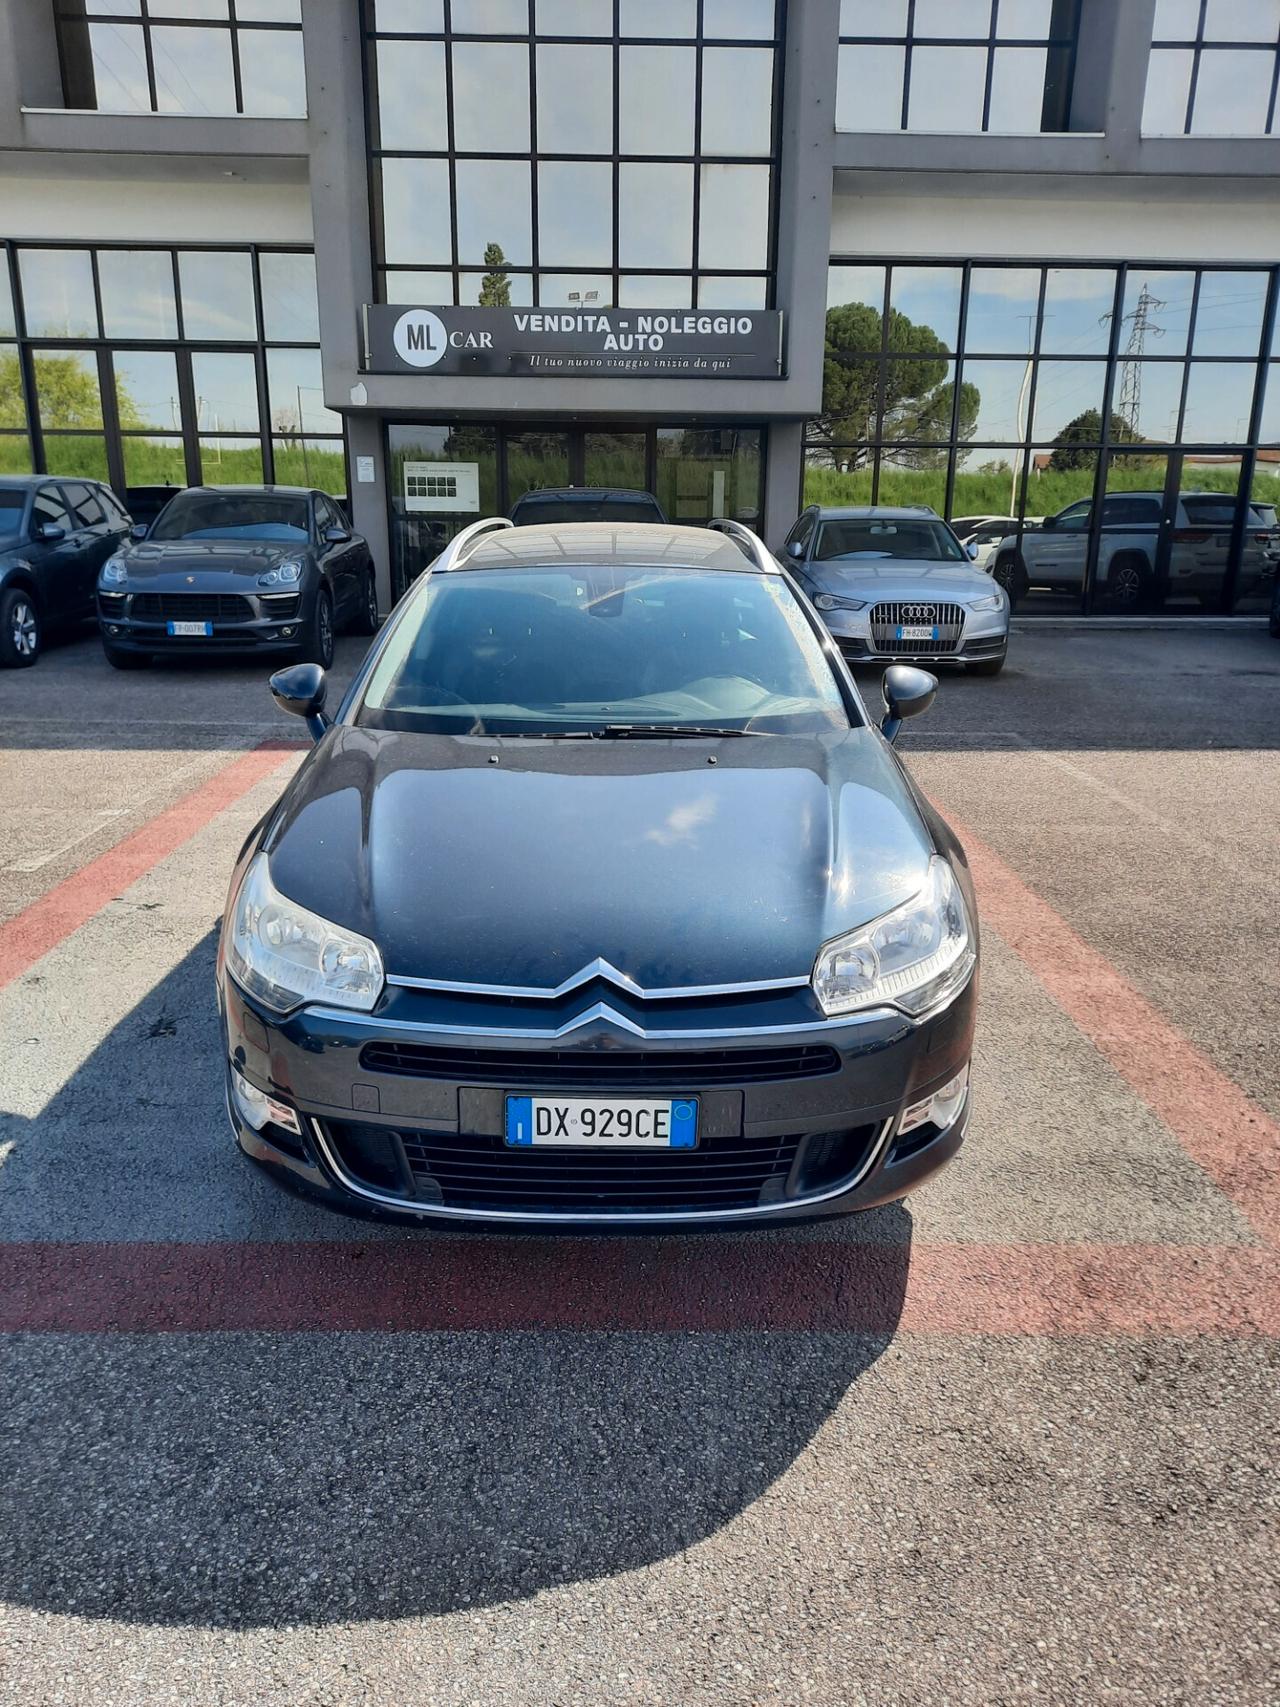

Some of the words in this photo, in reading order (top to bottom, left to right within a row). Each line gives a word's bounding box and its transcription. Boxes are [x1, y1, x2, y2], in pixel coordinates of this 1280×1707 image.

[513, 314, 611, 333] VENDITA
[637, 316, 753, 335] NOLEGGIO
[407, 324, 437, 350] ML
[449, 331, 493, 348] CAR
[603, 334, 664, 351] AUTO
[529, 355, 541, 366] Il
[544, 357, 563, 367] tuo
[567, 358, 603, 367] nuovo
[606, 357, 650, 369] viaggio
[654, 357, 689, 368] inizia
[693, 357, 708, 368] da
[712, 358, 731, 369] qui
[536, 1106, 569, 1137] DX
[580, 1108, 670, 1138] 929CE
